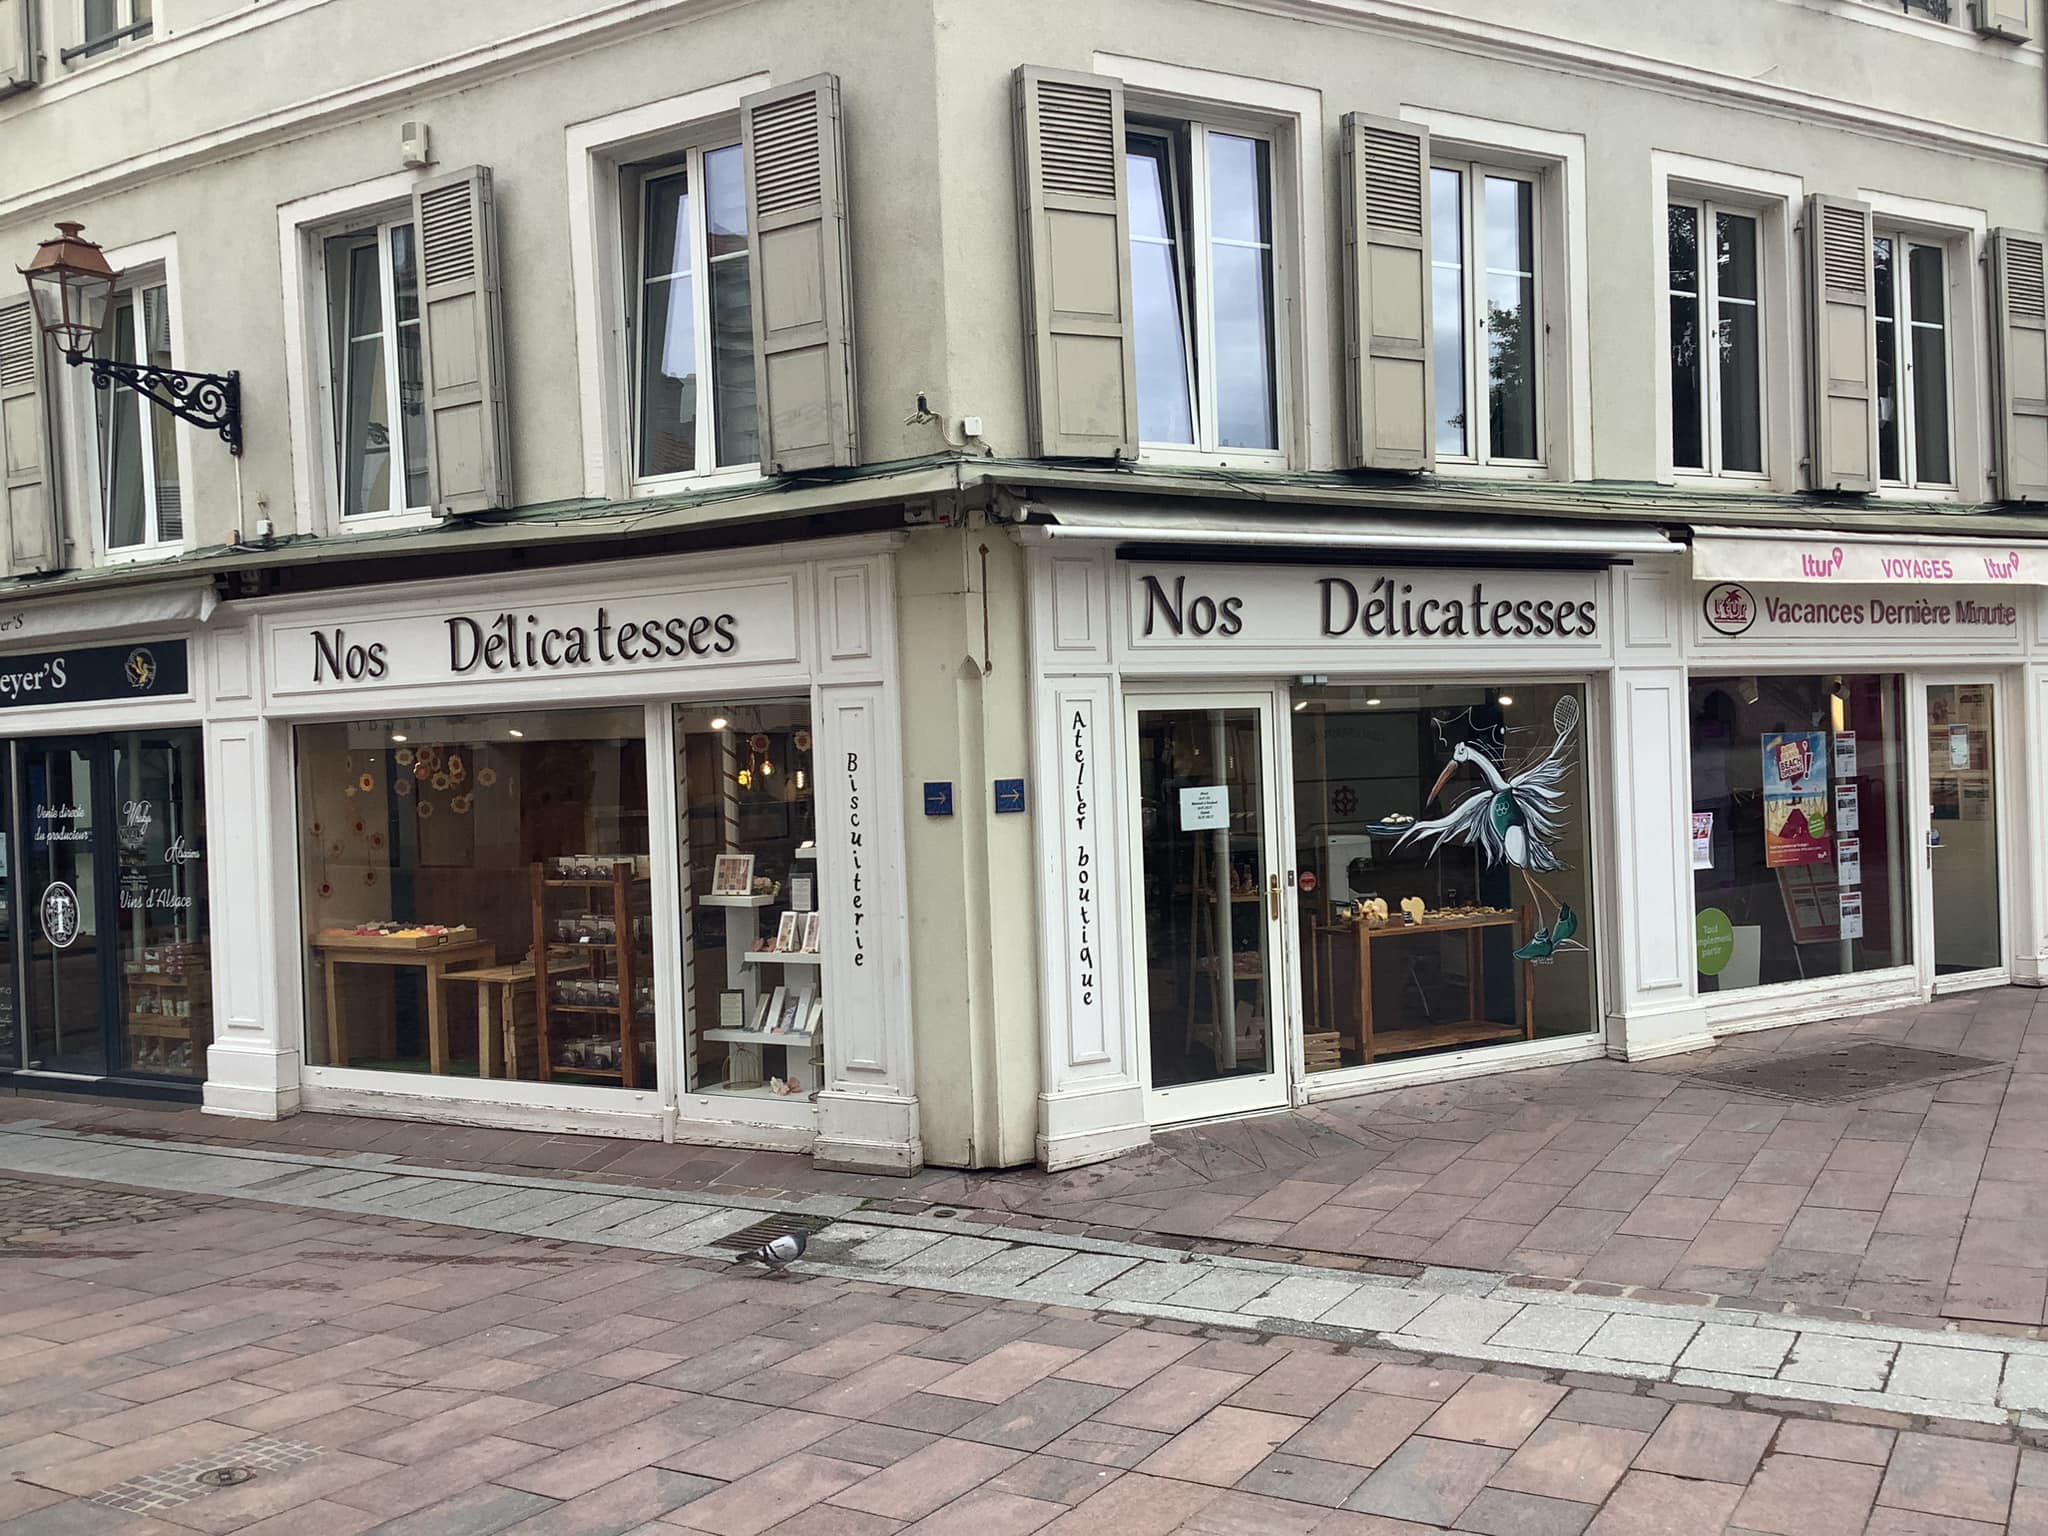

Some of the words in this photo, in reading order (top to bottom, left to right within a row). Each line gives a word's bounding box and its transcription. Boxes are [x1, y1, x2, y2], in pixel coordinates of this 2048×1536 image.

[1802, 551, 1834, 577] ltur
[1881, 558, 1953, 579] VOYAGES
[1983, 557, 2012, 579] ltur
[1140, 575, 1243, 637] Nos
[1316, 575, 1597, 638] Délicatesses
[1765, 596, 1865, 625] Vacances
[1870, 597, 1951, 625] Dernière
[1956, 600, 2016, 626] Minute
[310, 627, 388, 683] Nos
[443, 607, 738, 674] Délicatesses
[1072, 710, 1087, 831] Atelier
[846, 752, 864, 967] Biscuiterie
[120, 889, 143, 908] Vins
[145, 887, 193, 908] d'Alsace
[1077, 845, 1094, 1006] boutique
